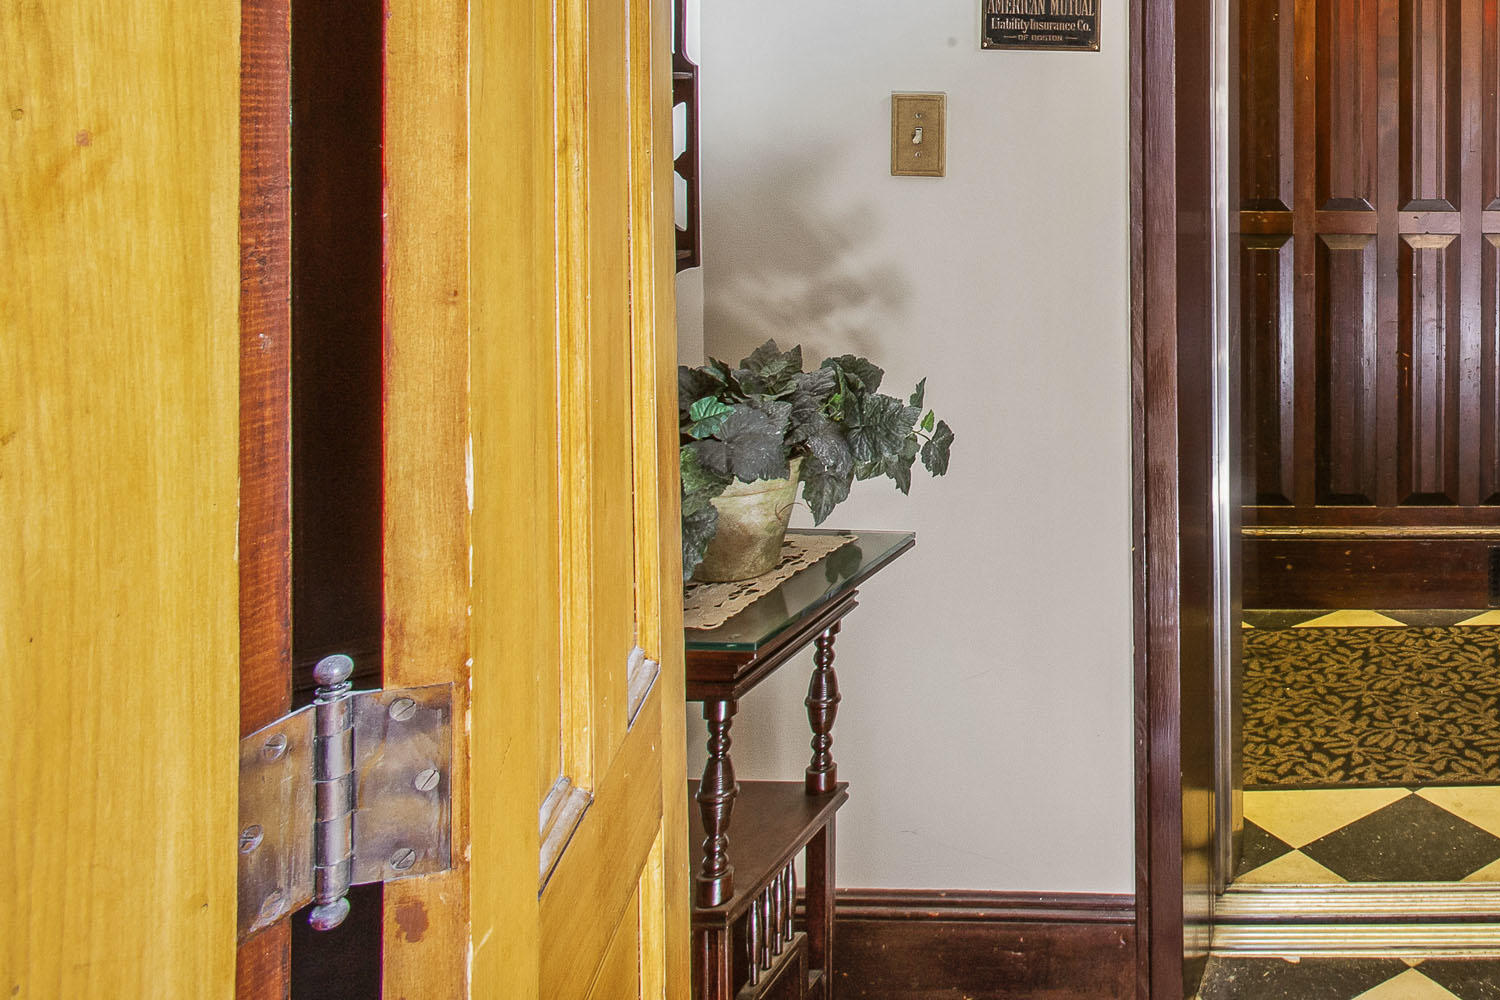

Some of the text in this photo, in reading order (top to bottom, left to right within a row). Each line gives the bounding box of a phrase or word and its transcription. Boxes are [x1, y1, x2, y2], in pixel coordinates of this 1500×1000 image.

[991, 18, 1091, 33] Liability Insurance Co.
